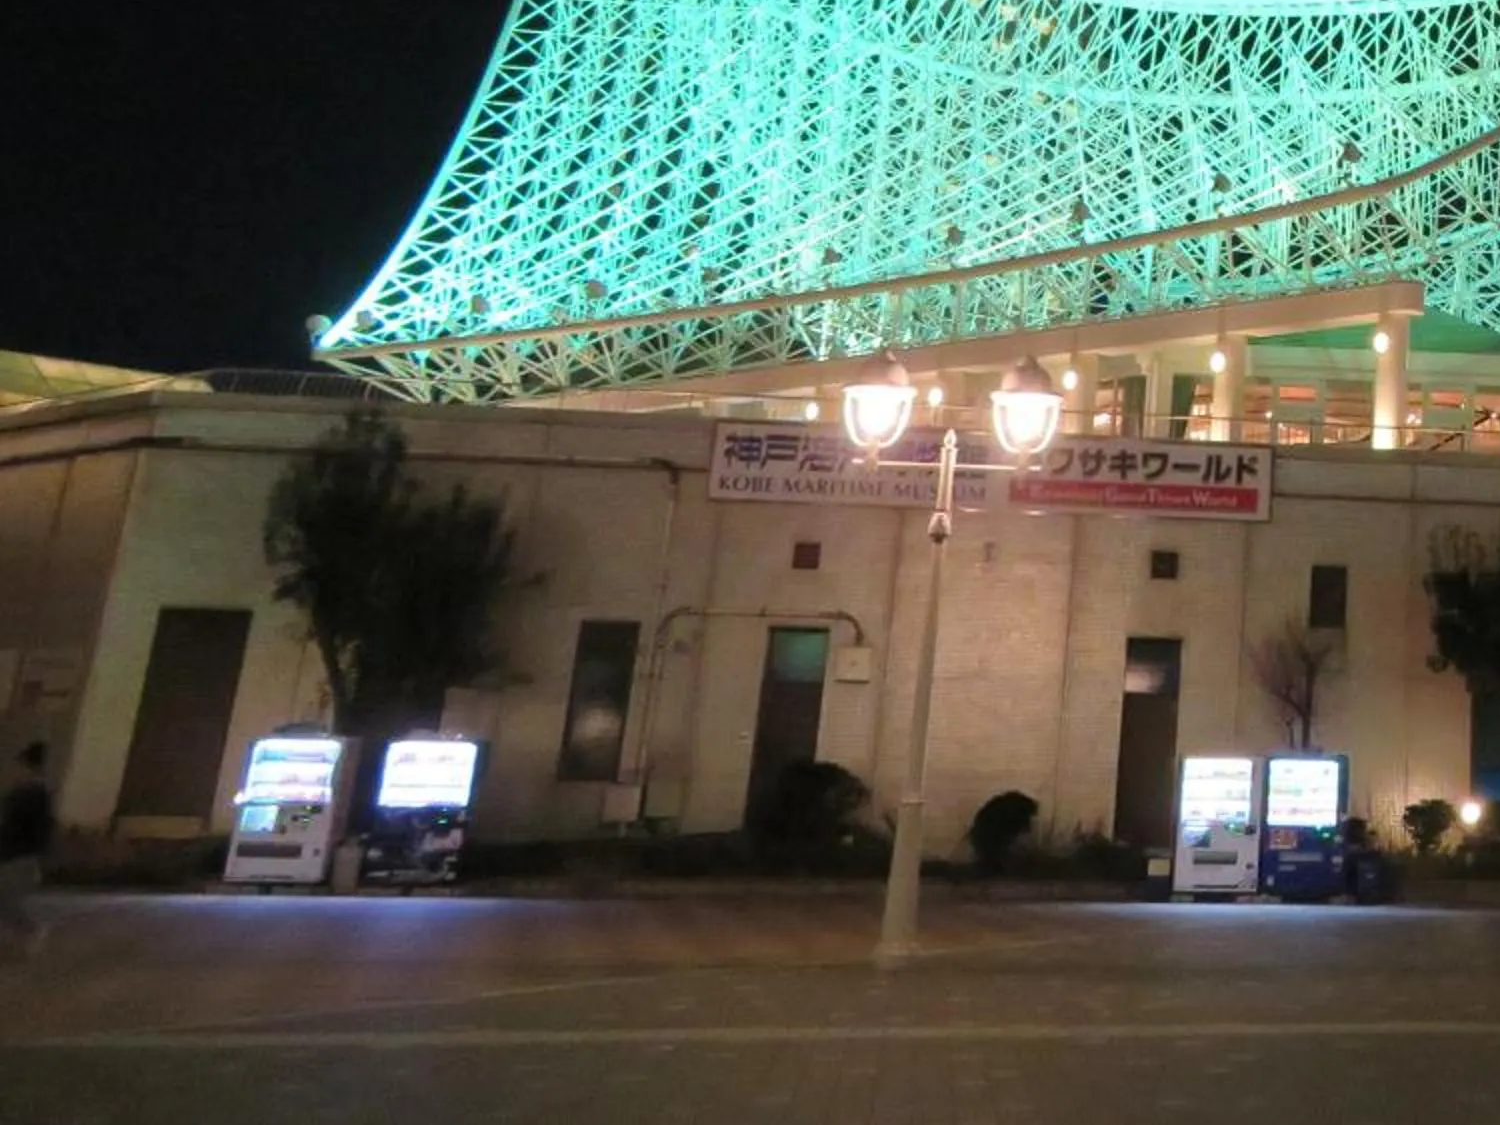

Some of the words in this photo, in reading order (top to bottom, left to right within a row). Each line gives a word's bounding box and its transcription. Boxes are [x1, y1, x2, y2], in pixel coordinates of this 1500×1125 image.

[1036, 447, 1258, 485] ワサキワールド
[719, 476, 774, 493] KOBE
[783, 477, 885, 497] MARITIME
[894, 480, 987, 502] MUSUM
